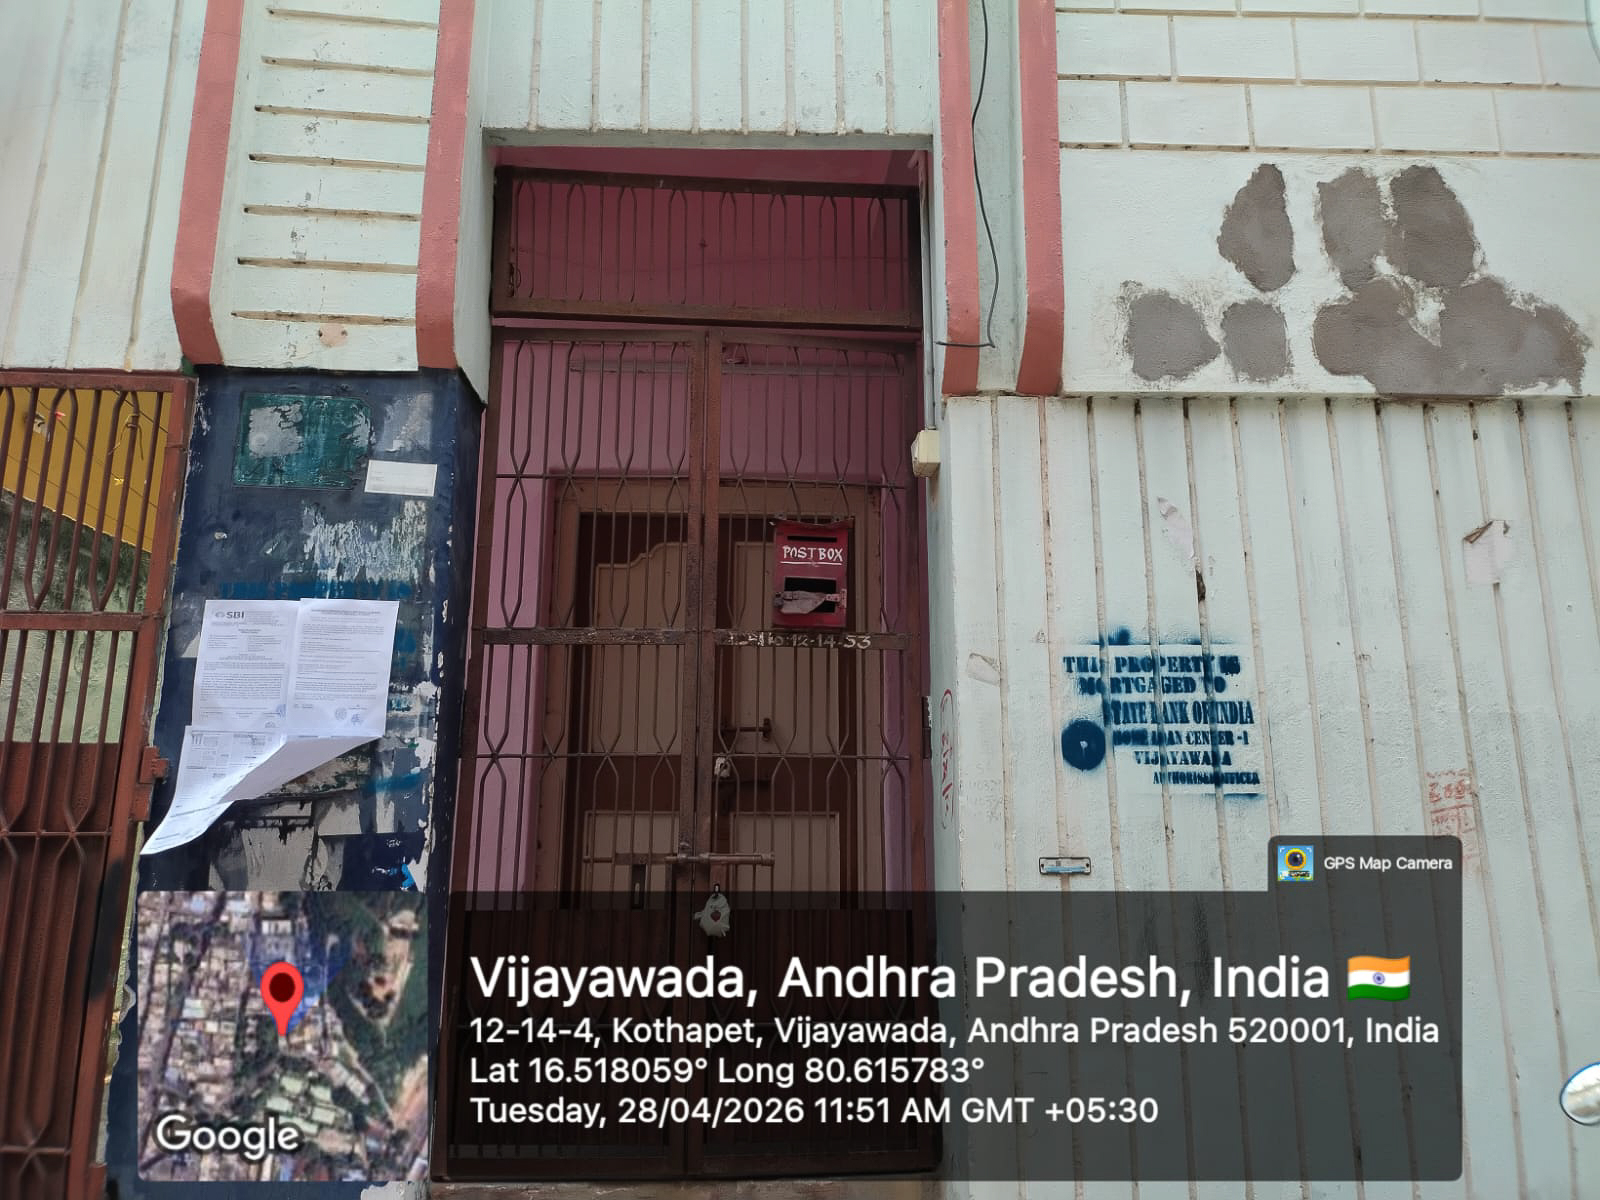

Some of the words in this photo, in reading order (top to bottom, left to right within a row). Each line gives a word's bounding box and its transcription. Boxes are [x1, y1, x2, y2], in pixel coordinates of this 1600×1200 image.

[226, 611, 245, 619] SBI
[1079, 676, 1196, 695] MORTGAGED
[1103, 701, 1148, 725] TATE
